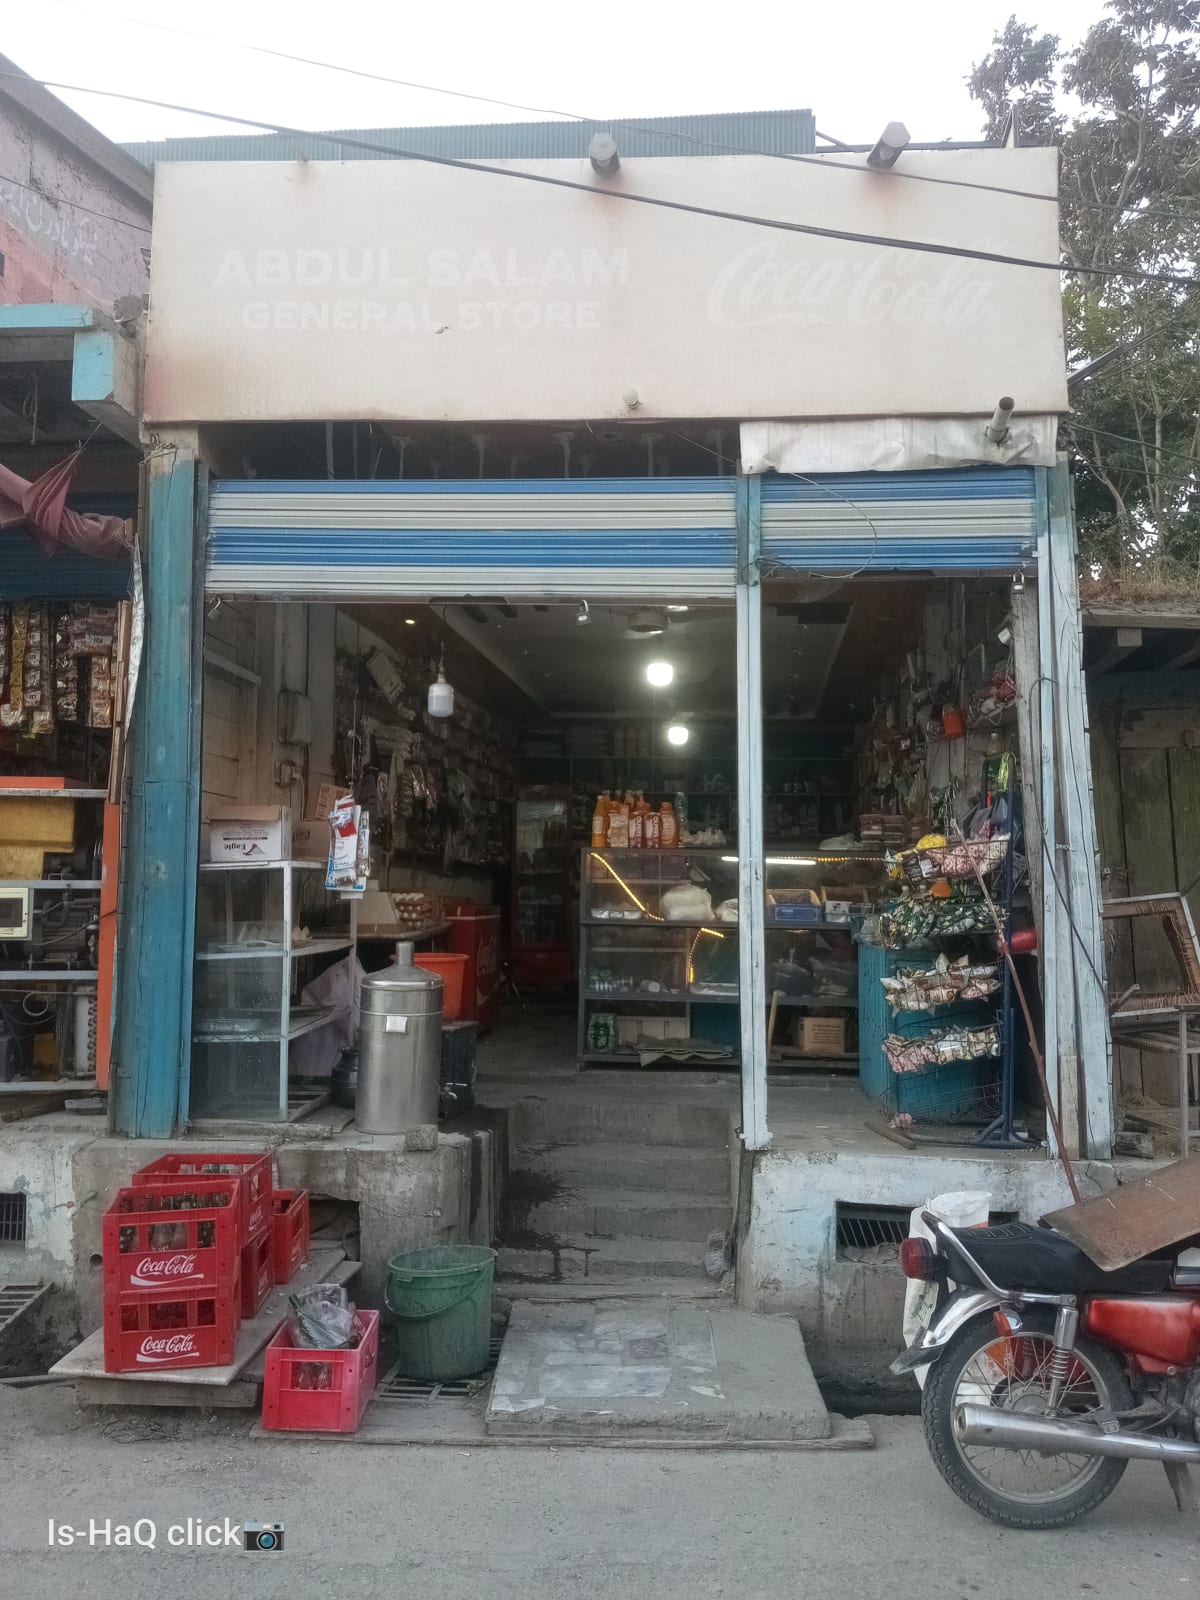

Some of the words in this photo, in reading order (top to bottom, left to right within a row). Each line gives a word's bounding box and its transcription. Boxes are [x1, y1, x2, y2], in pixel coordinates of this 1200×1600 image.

[214, 248, 408, 287] ABDUL
[426, 247, 629, 287] SALAM
[241, 300, 438, 331] GENERAL
[459, 300, 600, 330] STORE
[136, 1254, 197, 1277] Coca-Cola
[141, 1333, 196, 1355] Coca-Cola
